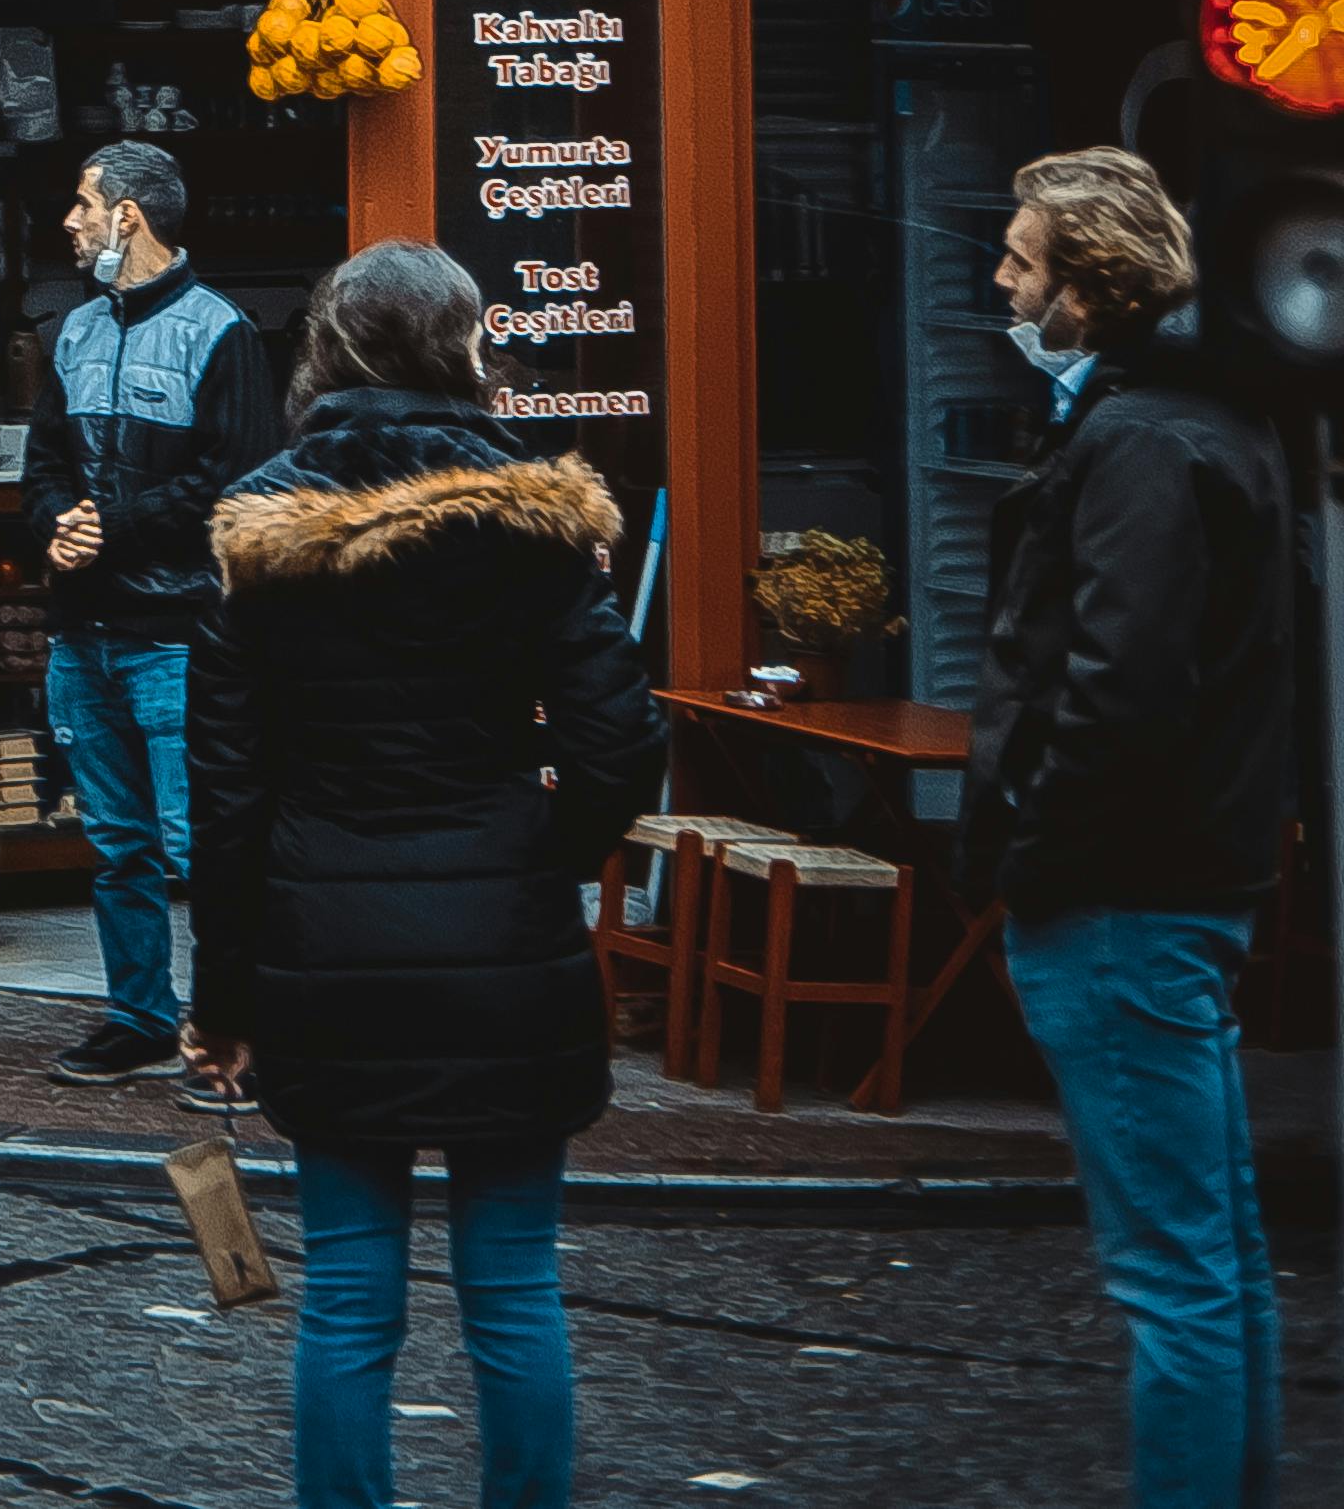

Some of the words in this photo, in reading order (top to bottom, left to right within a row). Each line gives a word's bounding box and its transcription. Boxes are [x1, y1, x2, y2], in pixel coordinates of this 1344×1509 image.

[473, 10, 624, 45] Kahvaltı
[487, 53, 612, 92] Tabağı
[475, 134, 632, 169] Yumurta
[479, 176, 631, 219] Çeşitleri
[514, 260, 601, 293] Tost
[484, 300, 636, 344] Çeşitleri
